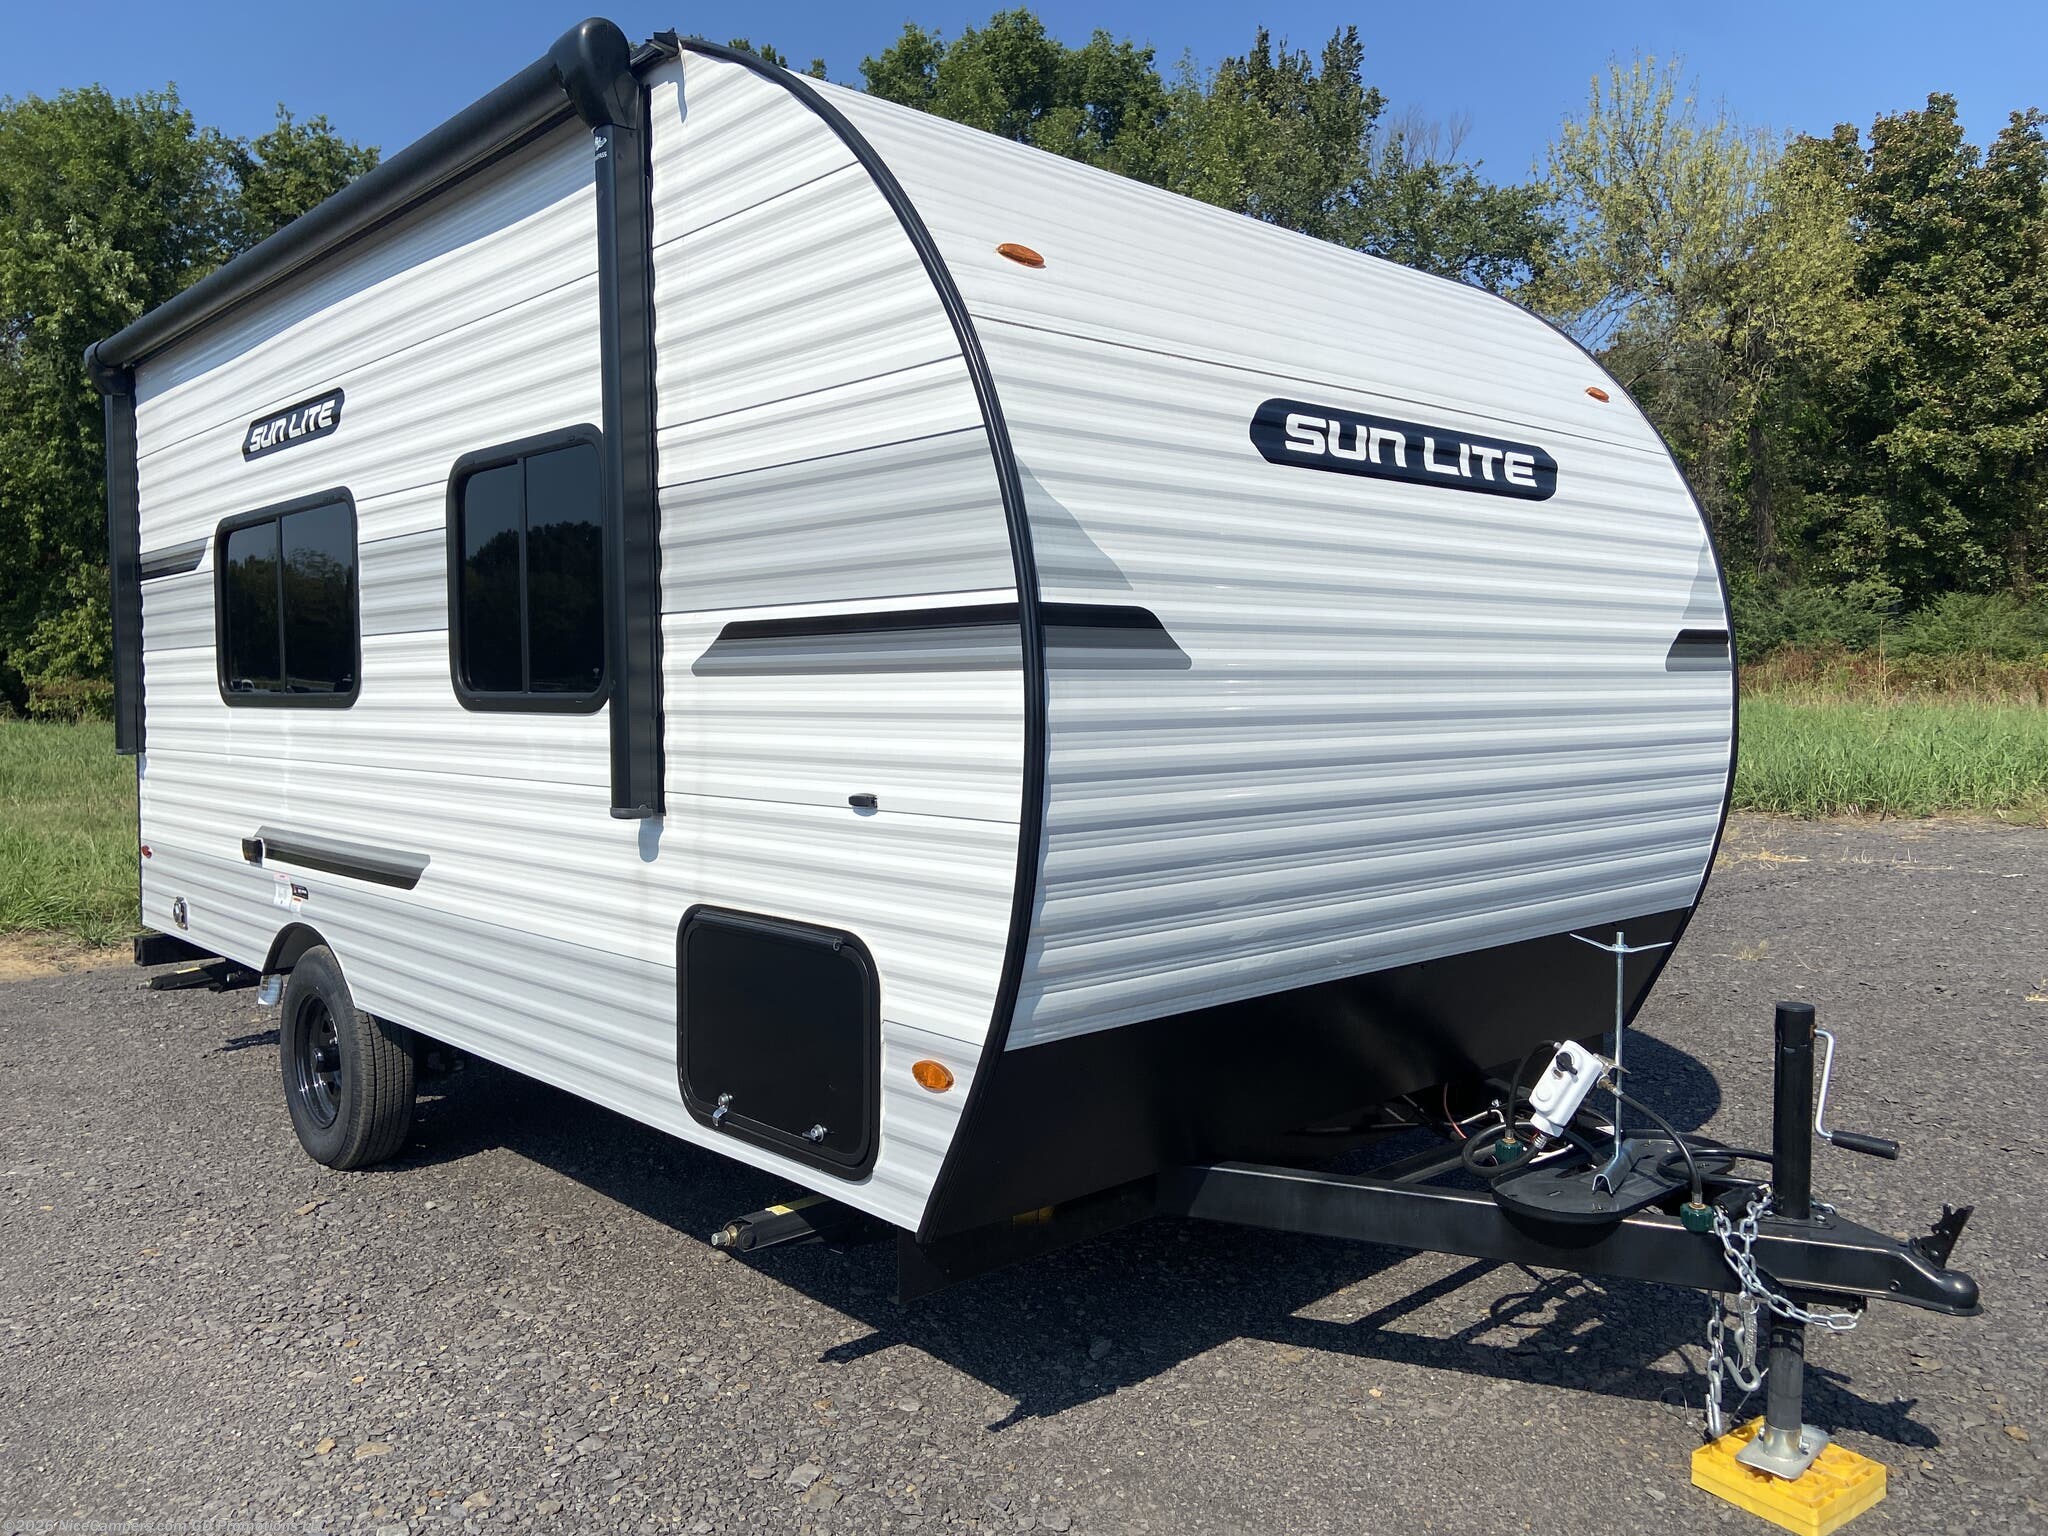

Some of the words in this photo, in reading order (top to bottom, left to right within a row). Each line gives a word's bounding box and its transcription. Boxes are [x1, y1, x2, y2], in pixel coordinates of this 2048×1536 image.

[249, 418, 287, 452] SUN
[289, 399, 336, 438] LITE
[1285, 413, 1407, 468] SUN
[1423, 436, 1538, 487] LITE
